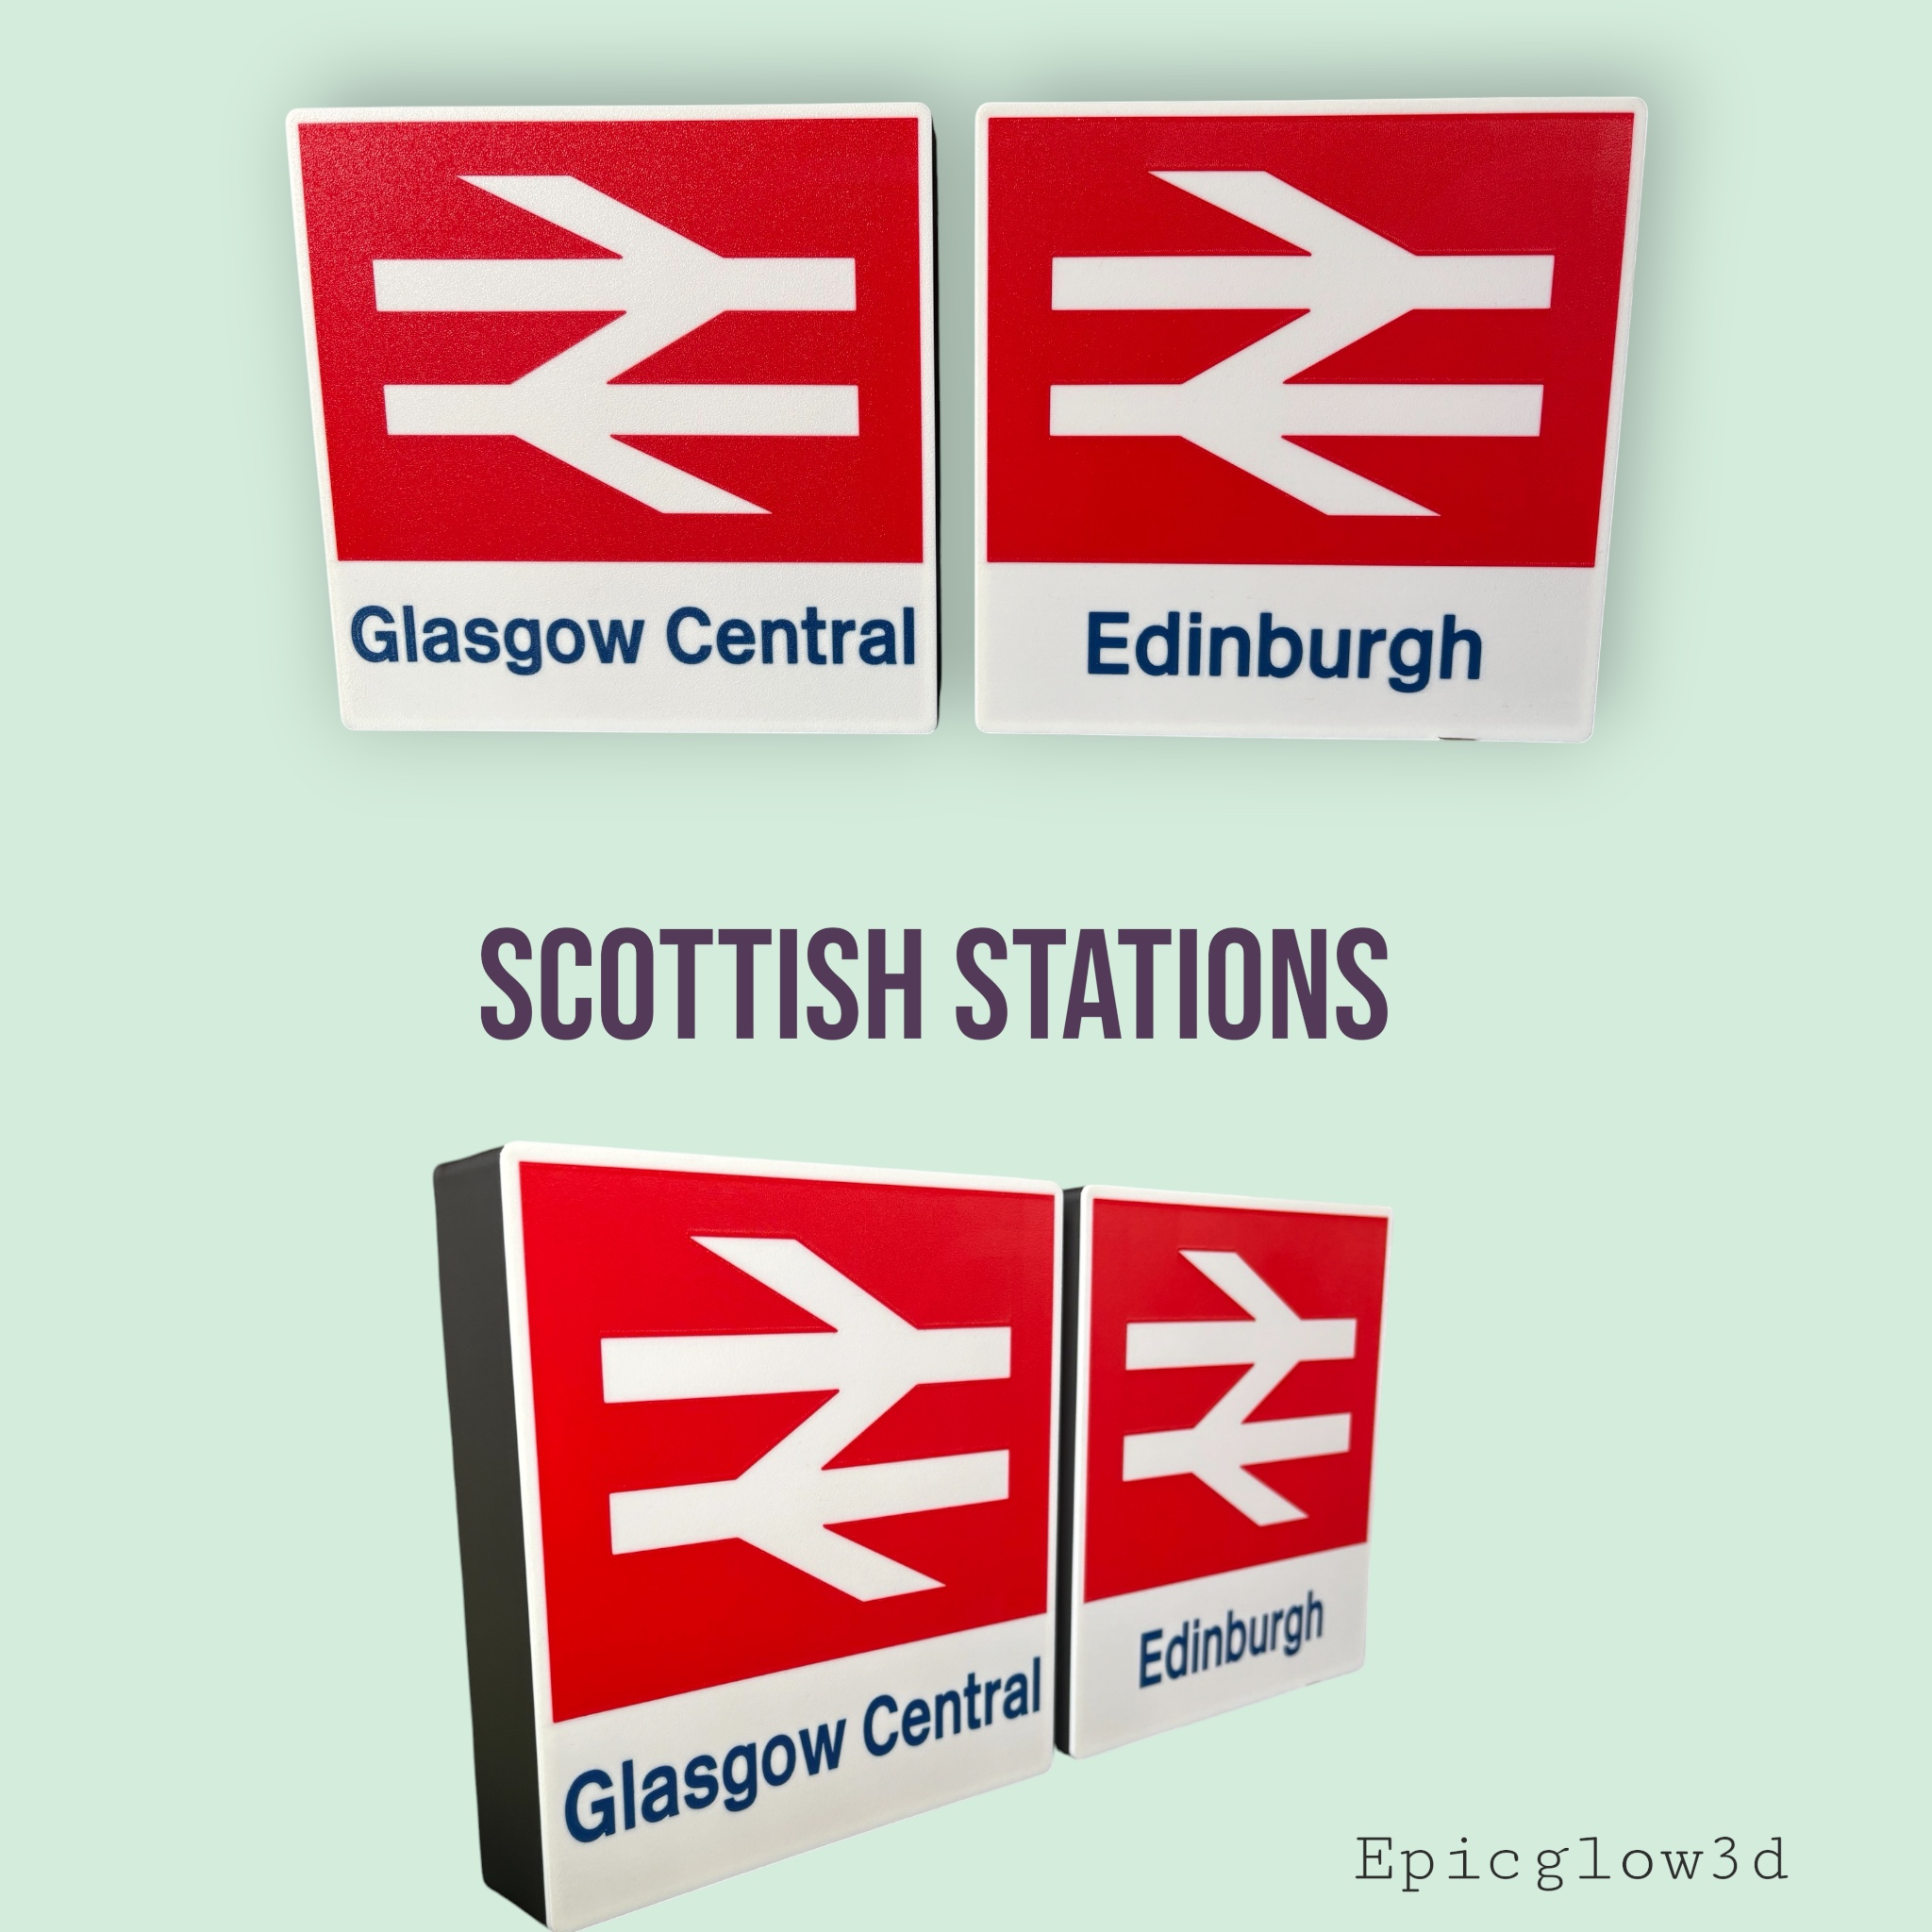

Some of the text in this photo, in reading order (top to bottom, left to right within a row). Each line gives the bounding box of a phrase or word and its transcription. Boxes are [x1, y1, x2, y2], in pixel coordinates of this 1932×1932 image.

[350, 605, 916, 676] Glasgow Central
[1087, 611, 1483, 693] Edinburgh
[1138, 1590, 1324, 1690] Edinburgh
[564, 1657, 1041, 1844] Glasgow Central
